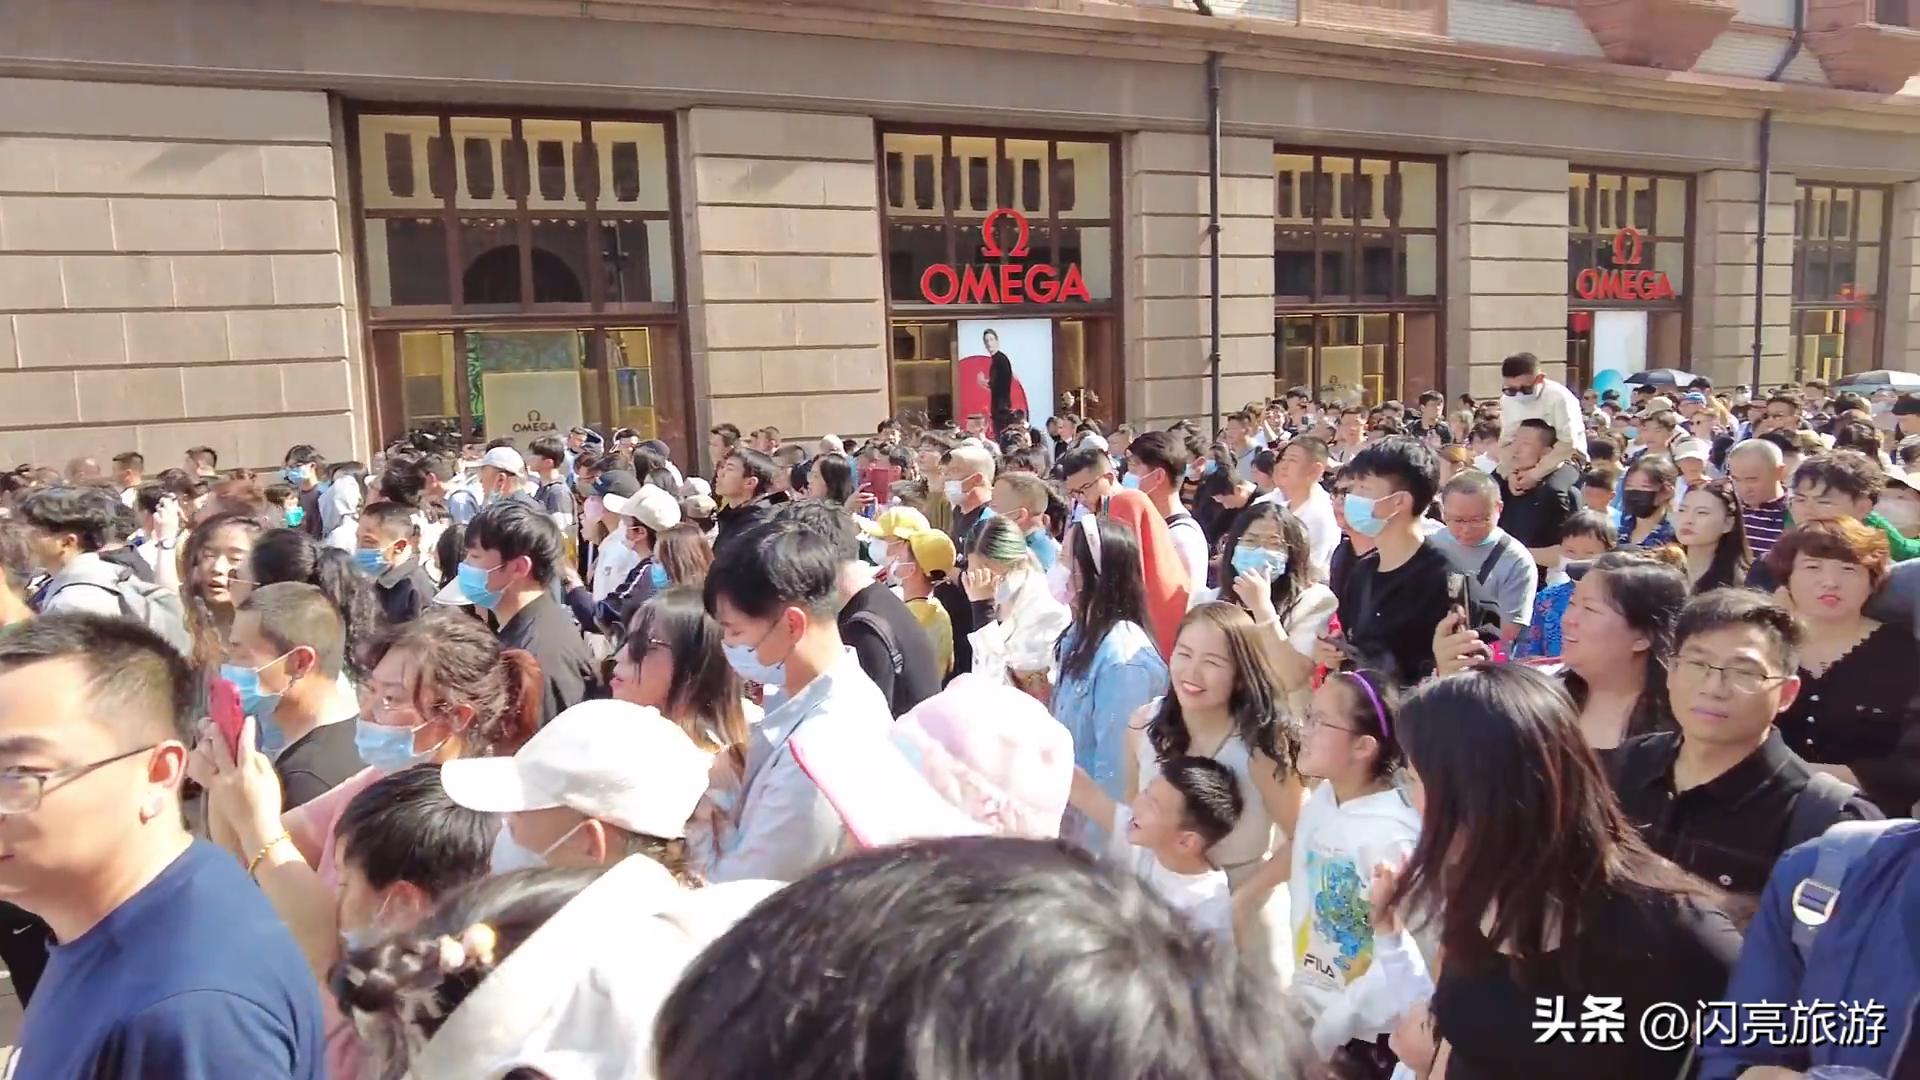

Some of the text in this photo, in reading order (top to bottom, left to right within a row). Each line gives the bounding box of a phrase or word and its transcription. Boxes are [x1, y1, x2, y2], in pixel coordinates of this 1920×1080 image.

[920, 262, 1092, 304] OMEGA
[1576, 268, 1675, 300] OMEGA
[512, 422, 559, 433] OMEGA
[1303, 953, 1335, 979] FILA
